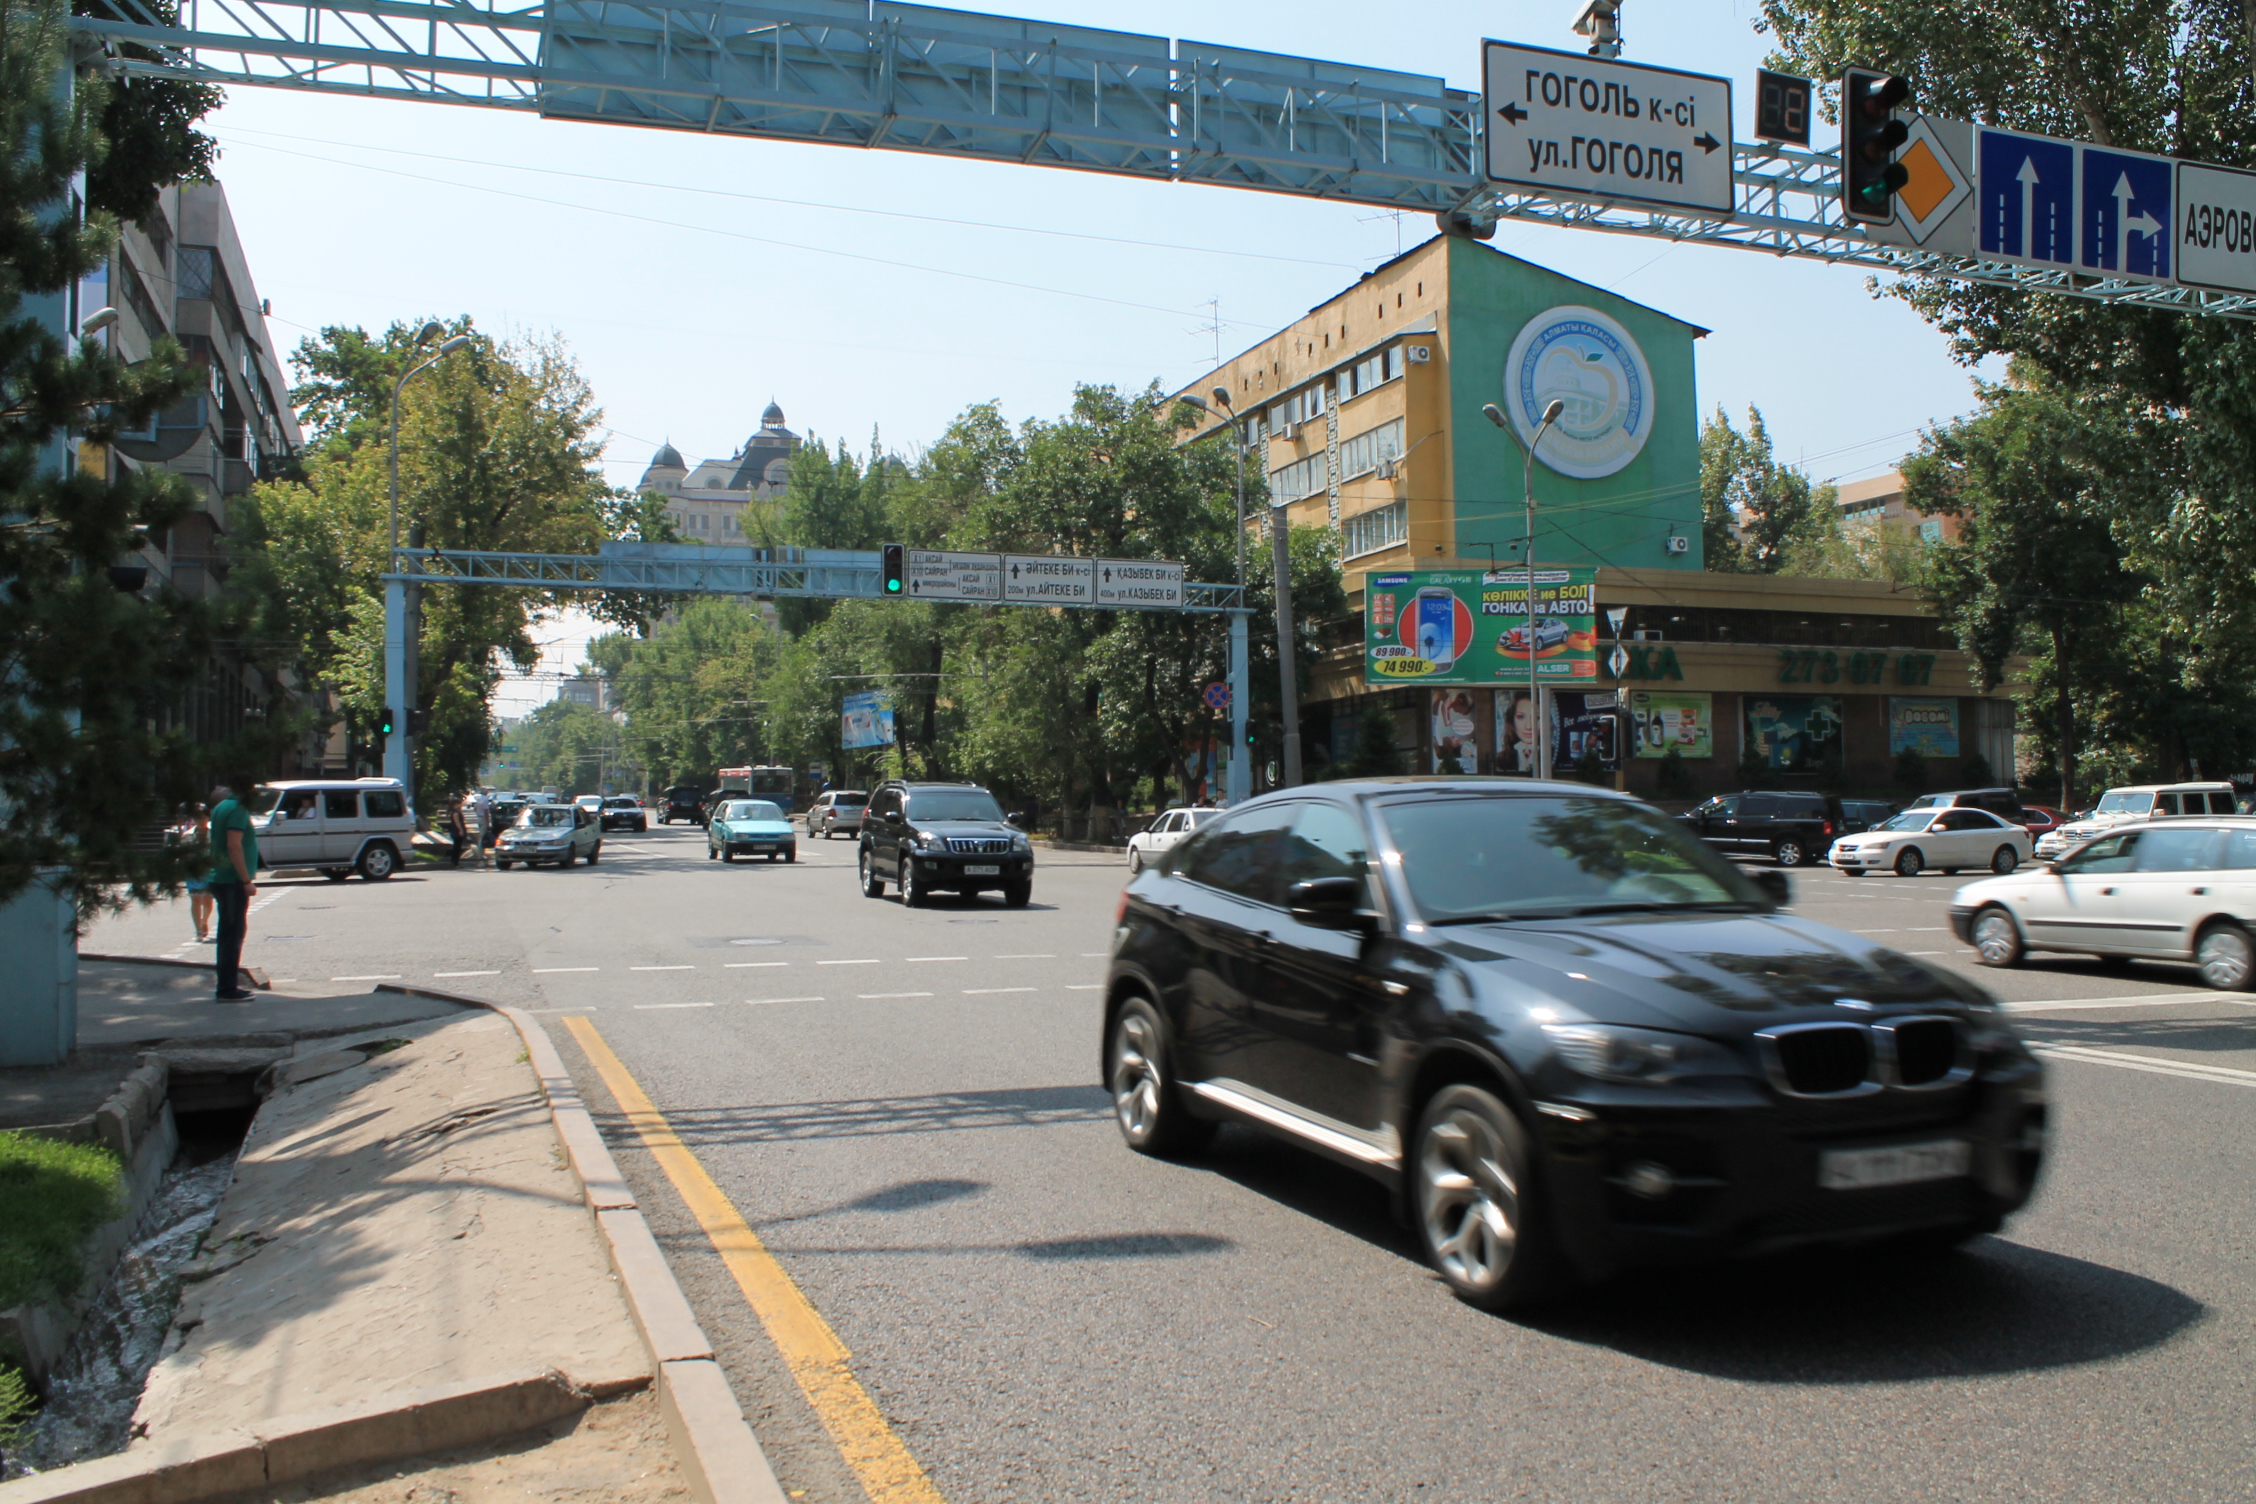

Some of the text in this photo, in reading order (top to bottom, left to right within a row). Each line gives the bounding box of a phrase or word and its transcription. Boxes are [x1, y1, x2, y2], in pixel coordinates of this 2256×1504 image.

[1526, 69, 1696, 128] ГОГОЛЬ к-сі
[1527, 136, 1684, 185] ул.ГОГОЛЯ
[2184, 203, 2256, 254] АЭРОВ
[1543, 323, 1580, 343] АЛМАТЫ
[1026, 560, 1060, 575] ӘЙТЕКЕ
[1062, 563, 1074, 576] БИ
[1156, 569, 1167, 580] БИ
[1429, 577, 1457, 585] GALAXY
[1073, 585, 1085, 597] БИ
[1166, 589, 1177, 601] БИ
[1482, 588, 1537, 602] КӨЛІКК
[1482, 602, 1528, 613] ГОНКА
[1383, 660, 1397, 673] 74
[1537, 664, 1570, 673] ALSER
[1778, 650, 1937, 686] 273 07 07
